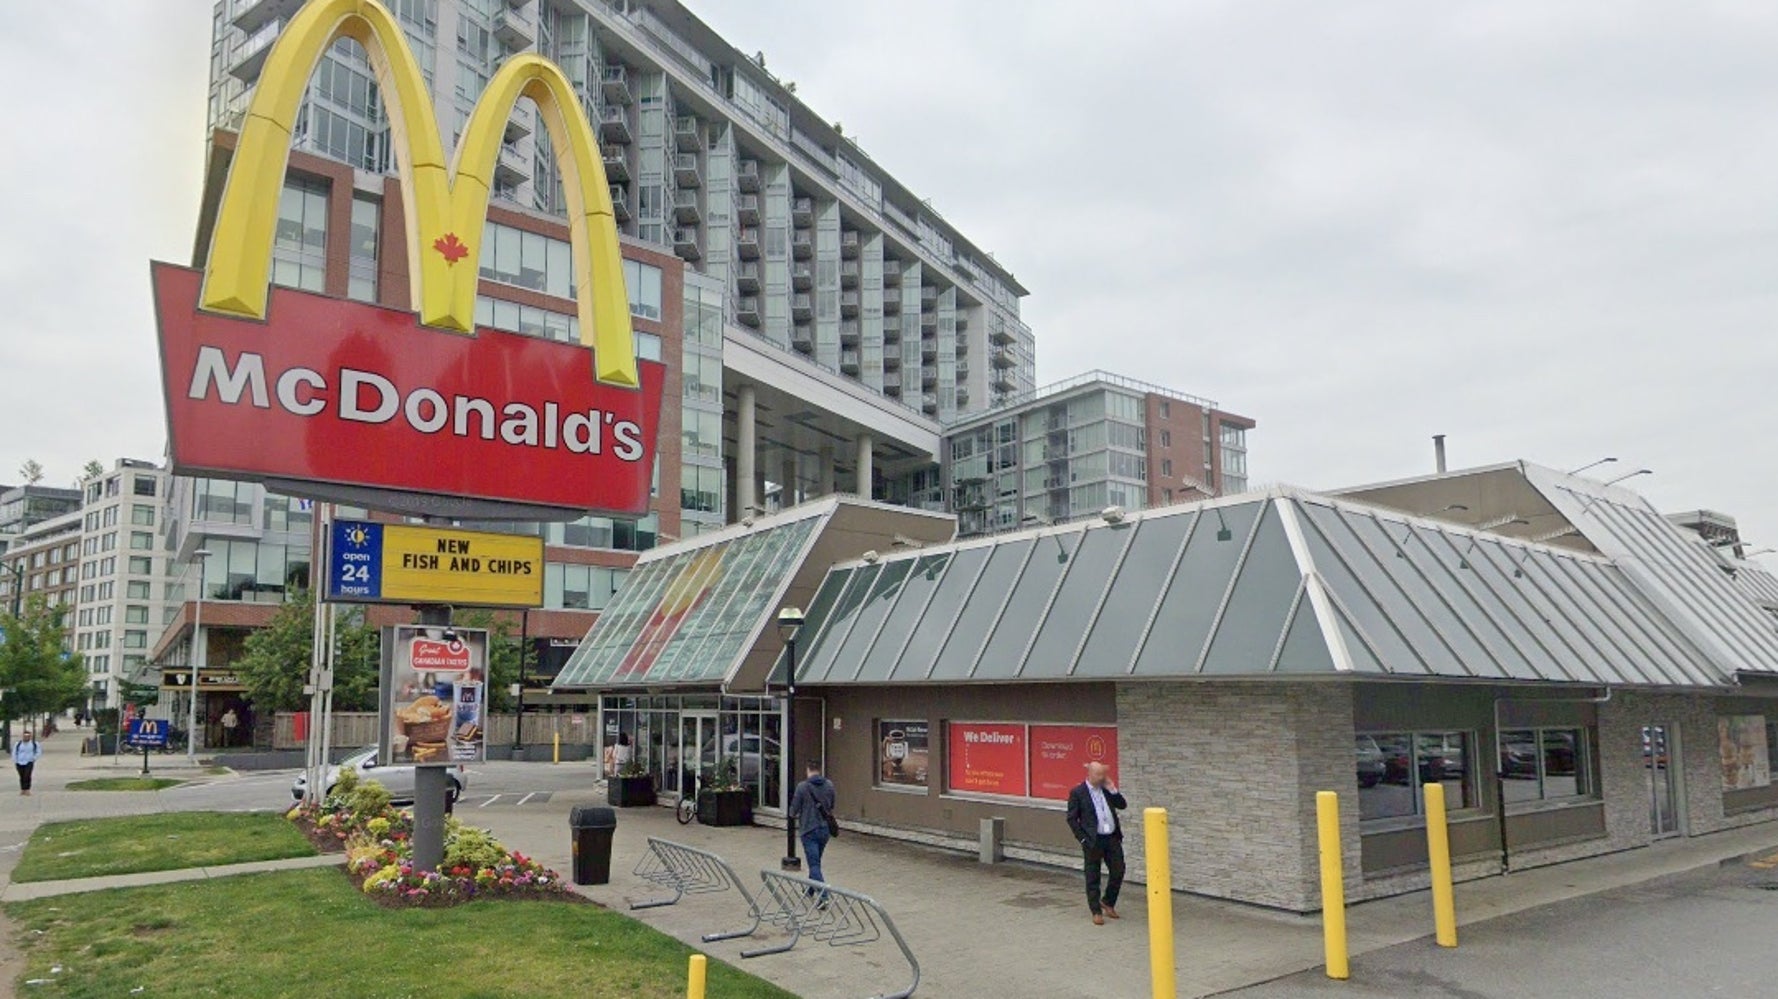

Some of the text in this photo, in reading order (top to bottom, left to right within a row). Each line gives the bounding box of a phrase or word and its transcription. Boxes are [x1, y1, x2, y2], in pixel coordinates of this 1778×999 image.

[188, 345, 645, 462] McDonald's
[437, 539, 470, 554] NEW
[342, 552, 370, 562] open
[403, 554, 532, 575] FISH AND CHIPS
[341, 564, 370, 582] 24
[340, 584, 370, 595] hours
[963, 731, 1014, 744] We Deliver
